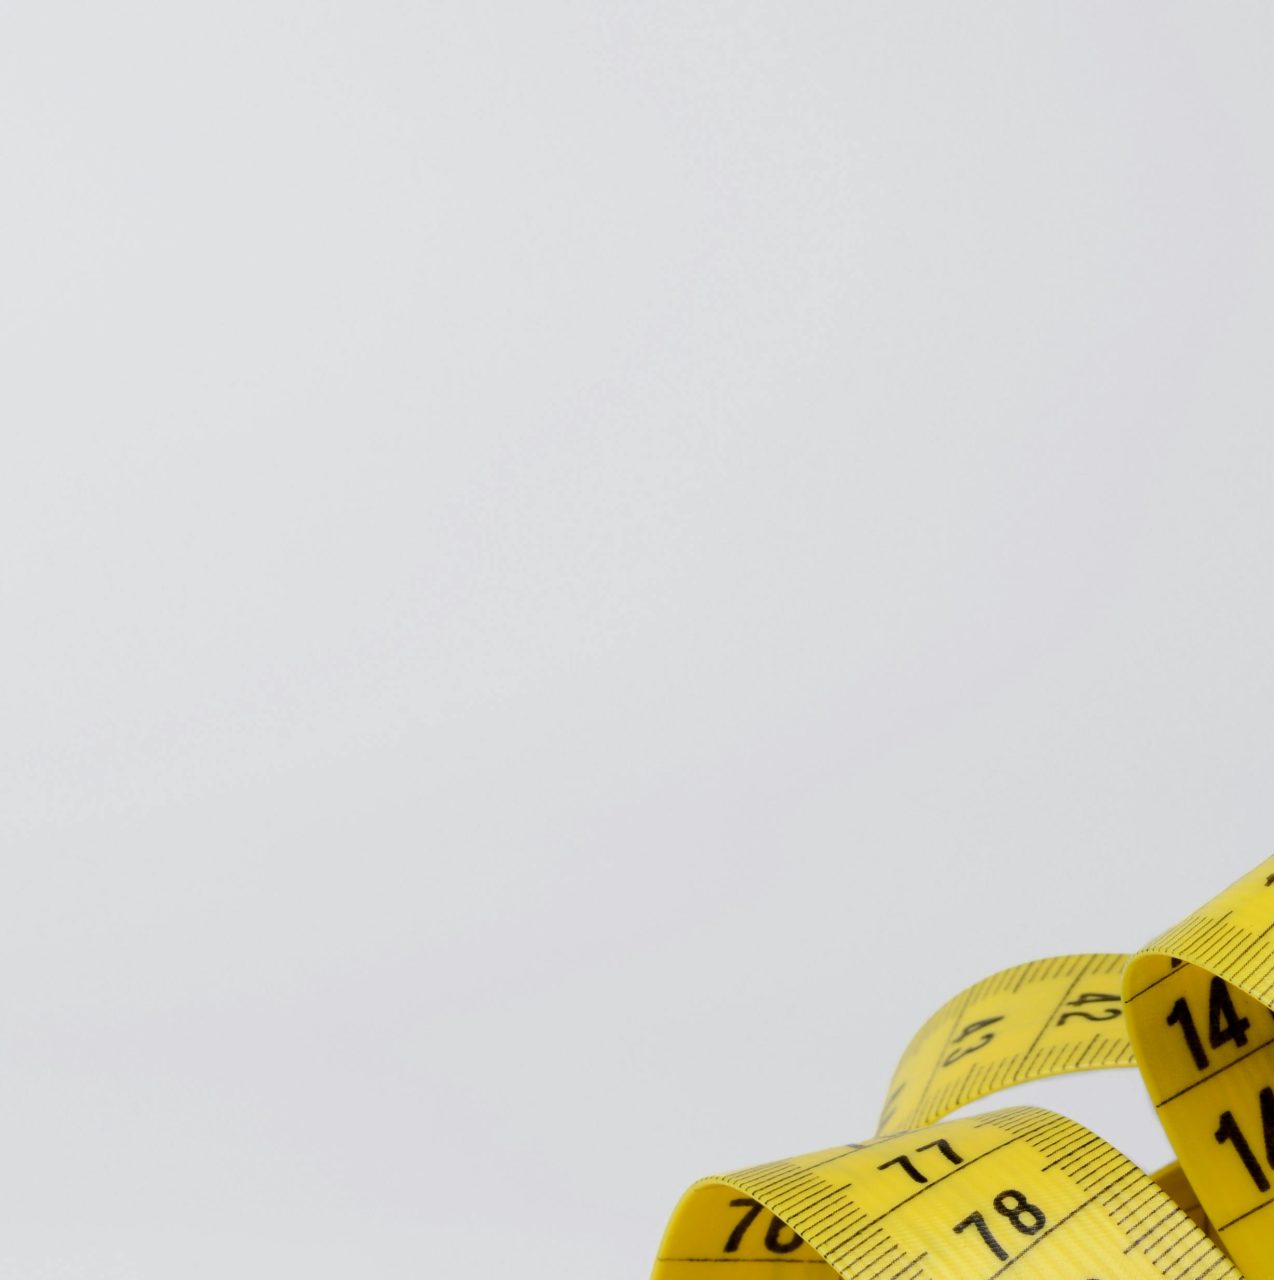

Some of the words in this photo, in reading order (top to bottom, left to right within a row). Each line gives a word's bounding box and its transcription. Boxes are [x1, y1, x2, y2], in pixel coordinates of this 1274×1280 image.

[1056, 992, 1122, 1026] 42
[877, 1139, 964, 1184] 77
[953, 1189, 1046, 1261] 78
